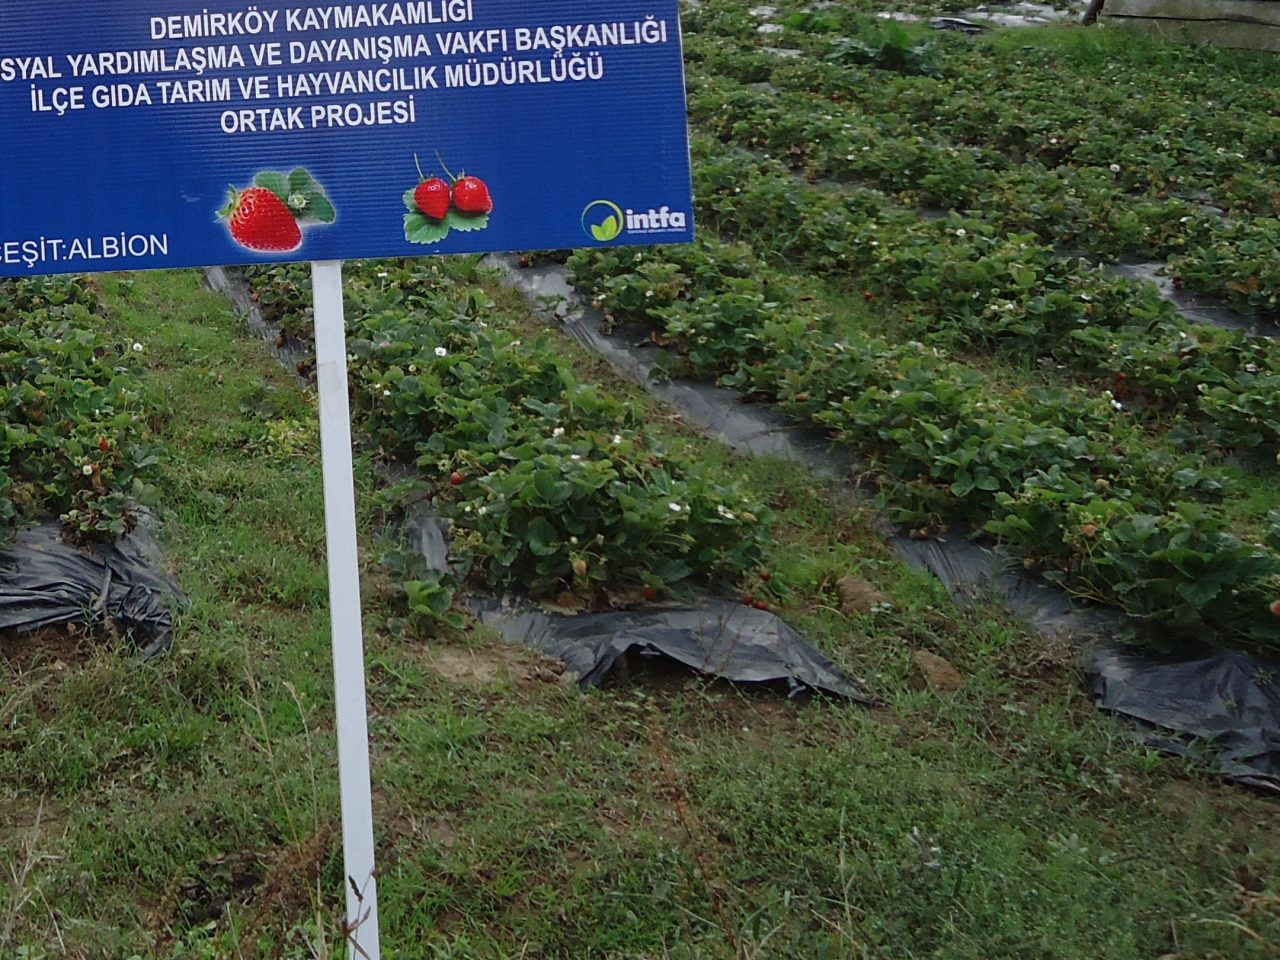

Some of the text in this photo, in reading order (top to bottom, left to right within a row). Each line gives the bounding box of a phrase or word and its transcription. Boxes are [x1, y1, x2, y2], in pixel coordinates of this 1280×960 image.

[150, 6, 278, 40] DEMİRKÖY
[67, 47, 245, 75] YARDIMLAŞMA
[251, 42, 282, 68] VE
[289, 34, 432, 66] DAYANIŞMA
[436, 29, 509, 54] VAKFI
[515, 15, 668, 51] BAŞKANLIĞI
[30, 53, 605, 117] İLÇE GIDA TARIM VE HAYVANCILIK MÜDÜRLÜĞÜ
[220, 95, 417, 133] ORTAK PROJESİ
[626, 206, 686, 229] intfa
